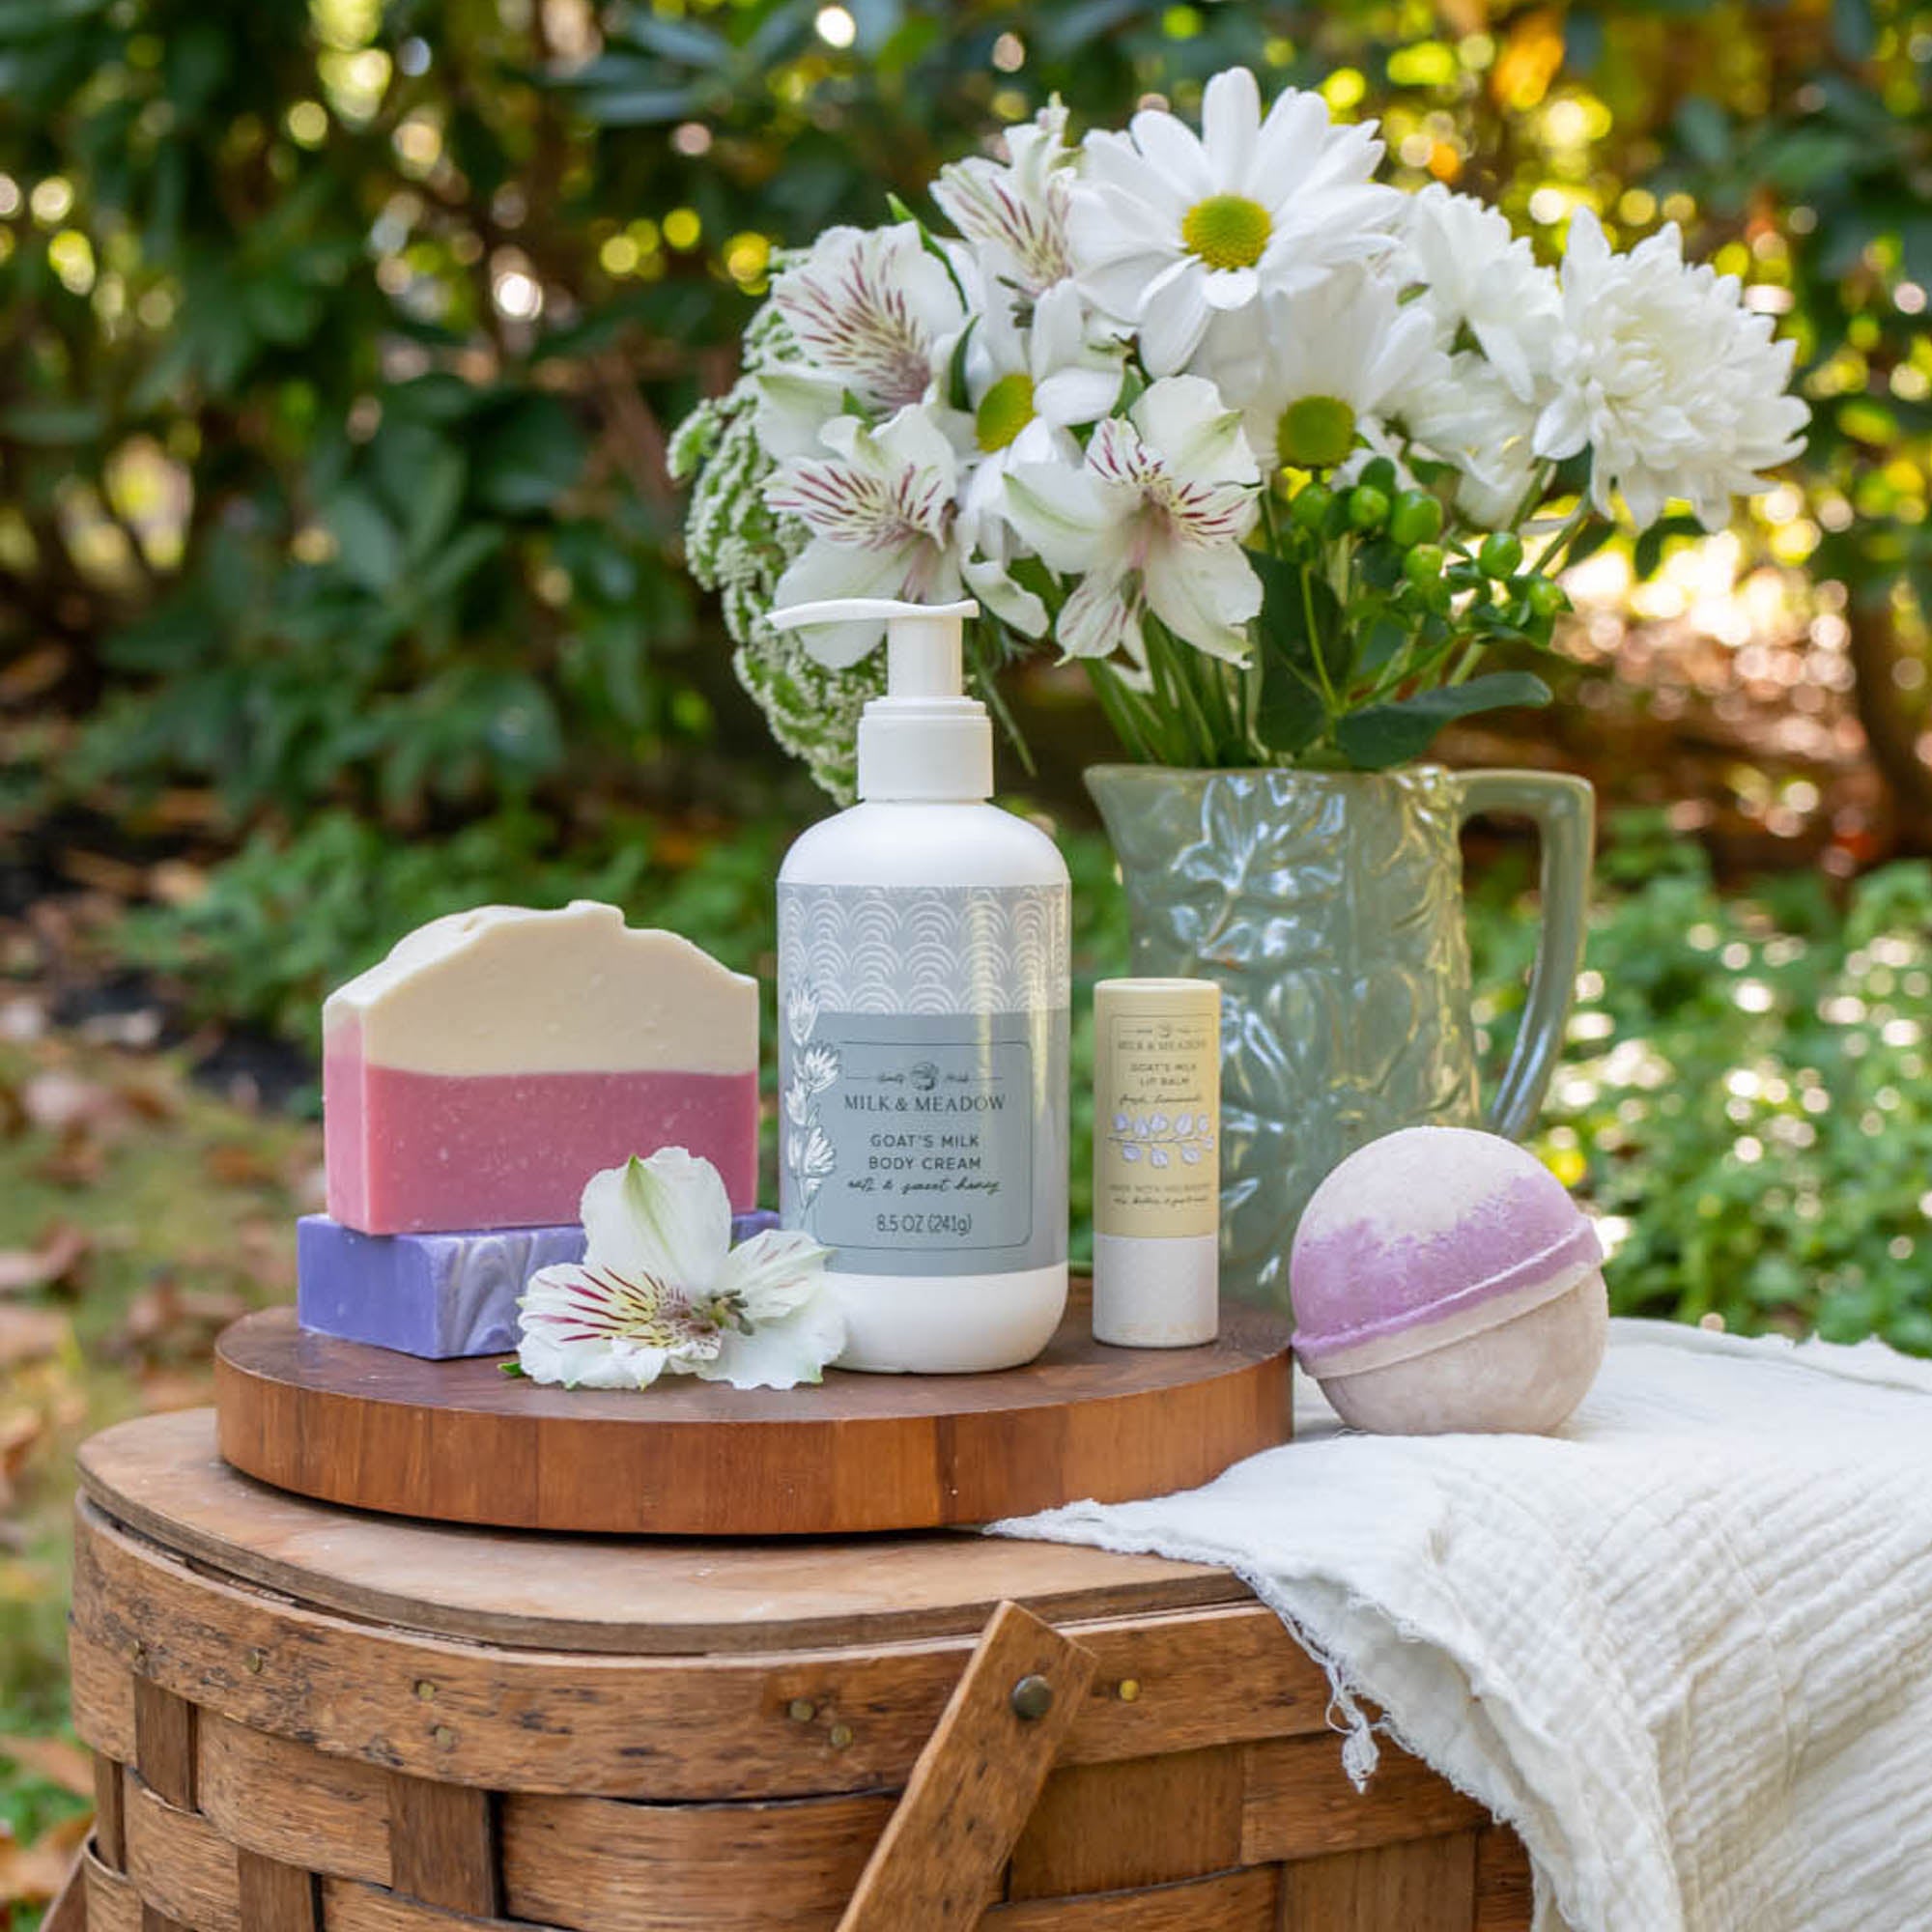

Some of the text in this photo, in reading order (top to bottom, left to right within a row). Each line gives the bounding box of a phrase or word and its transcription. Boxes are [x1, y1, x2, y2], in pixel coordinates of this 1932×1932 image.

[844, 1094, 1006, 1112] MILK & MEADOW
[870, 1134, 980, 1148] GOAT'S MILK
[868, 1156, 981, 1170] BODY CREAM
[876, 1213, 973, 1236] 8.5 OZ (241g)
